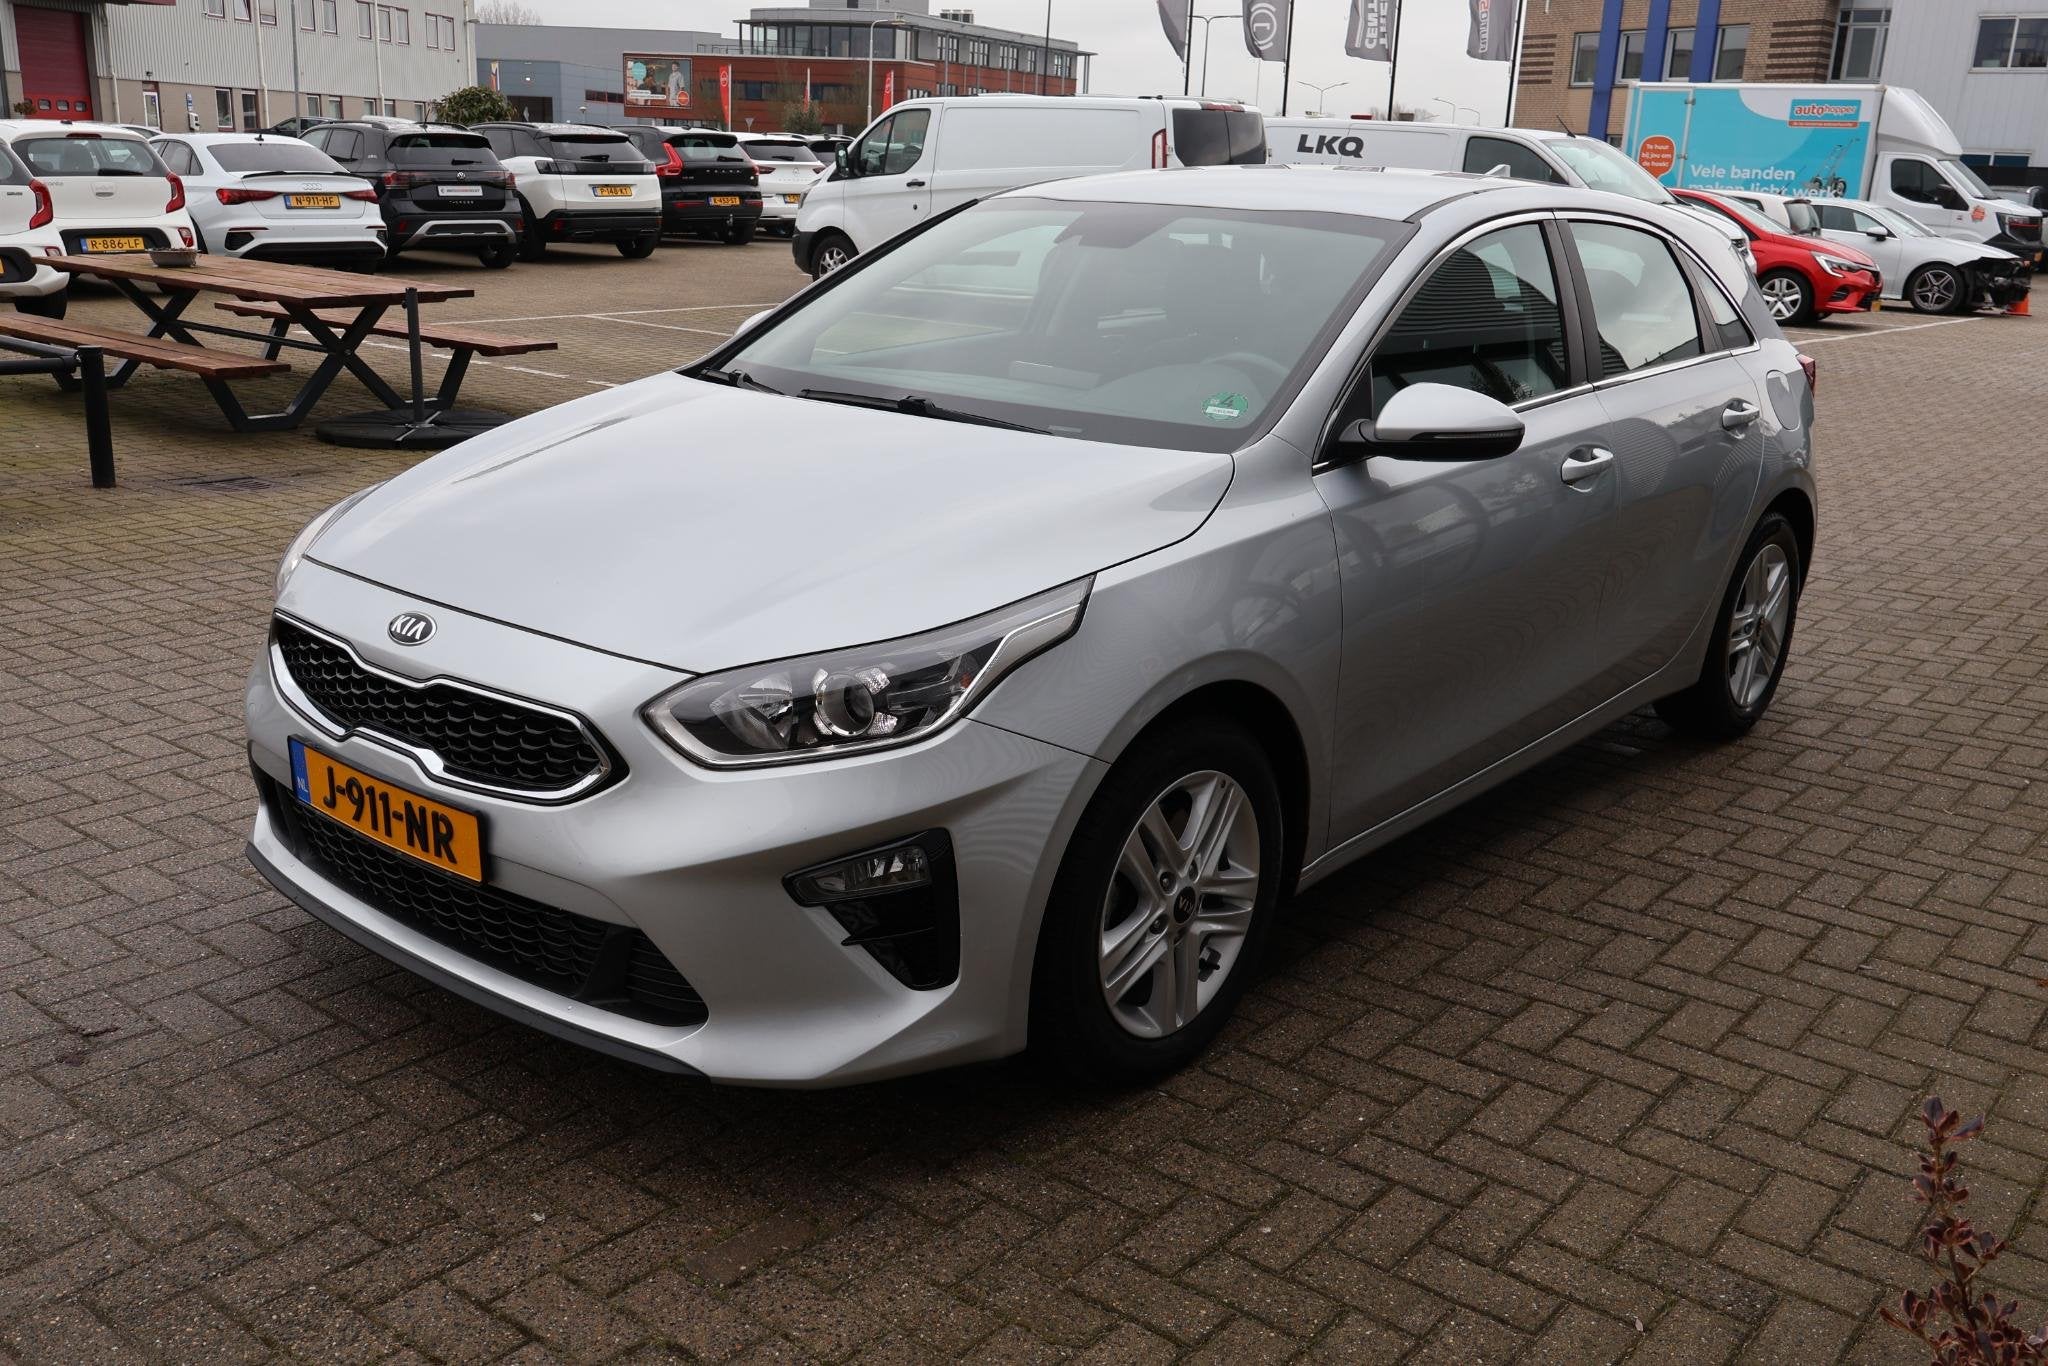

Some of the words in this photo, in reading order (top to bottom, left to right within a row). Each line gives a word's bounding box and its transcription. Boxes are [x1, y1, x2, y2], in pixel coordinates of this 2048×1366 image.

[1297, 134, 1364, 158] LKQ
[1690, 165, 1726, 178] Vele
[1731, 165, 1796, 180] banden
[295, 196, 335, 206] N-911-HF
[90, 238, 140, 249] R-886-LF
[391, 615, 427, 640] KIA
[296, 776, 309, 793] NL
[323, 765, 458, 865] J-911-NR
